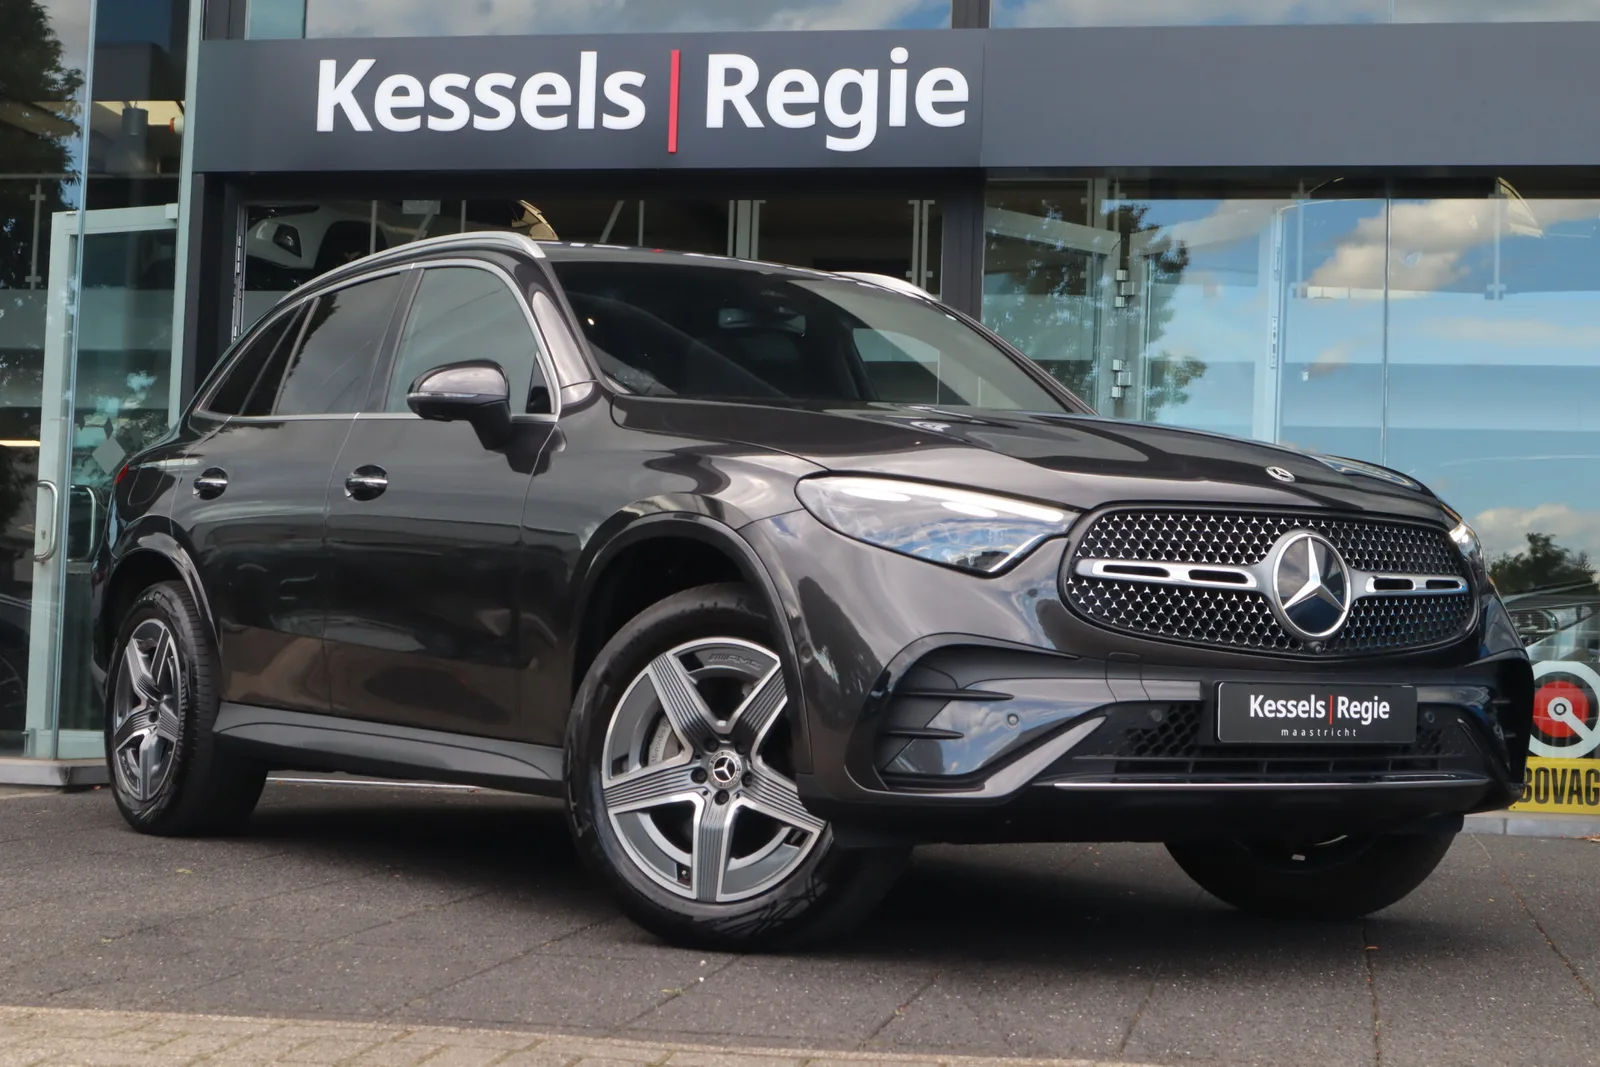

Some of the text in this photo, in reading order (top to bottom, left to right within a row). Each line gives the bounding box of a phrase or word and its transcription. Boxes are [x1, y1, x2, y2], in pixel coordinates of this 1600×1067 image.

[316, 46, 969, 152] Kessels Regie
[1250, 694, 1390, 726] Kessels Regie
[1281, 728, 1357, 737] maastricht
